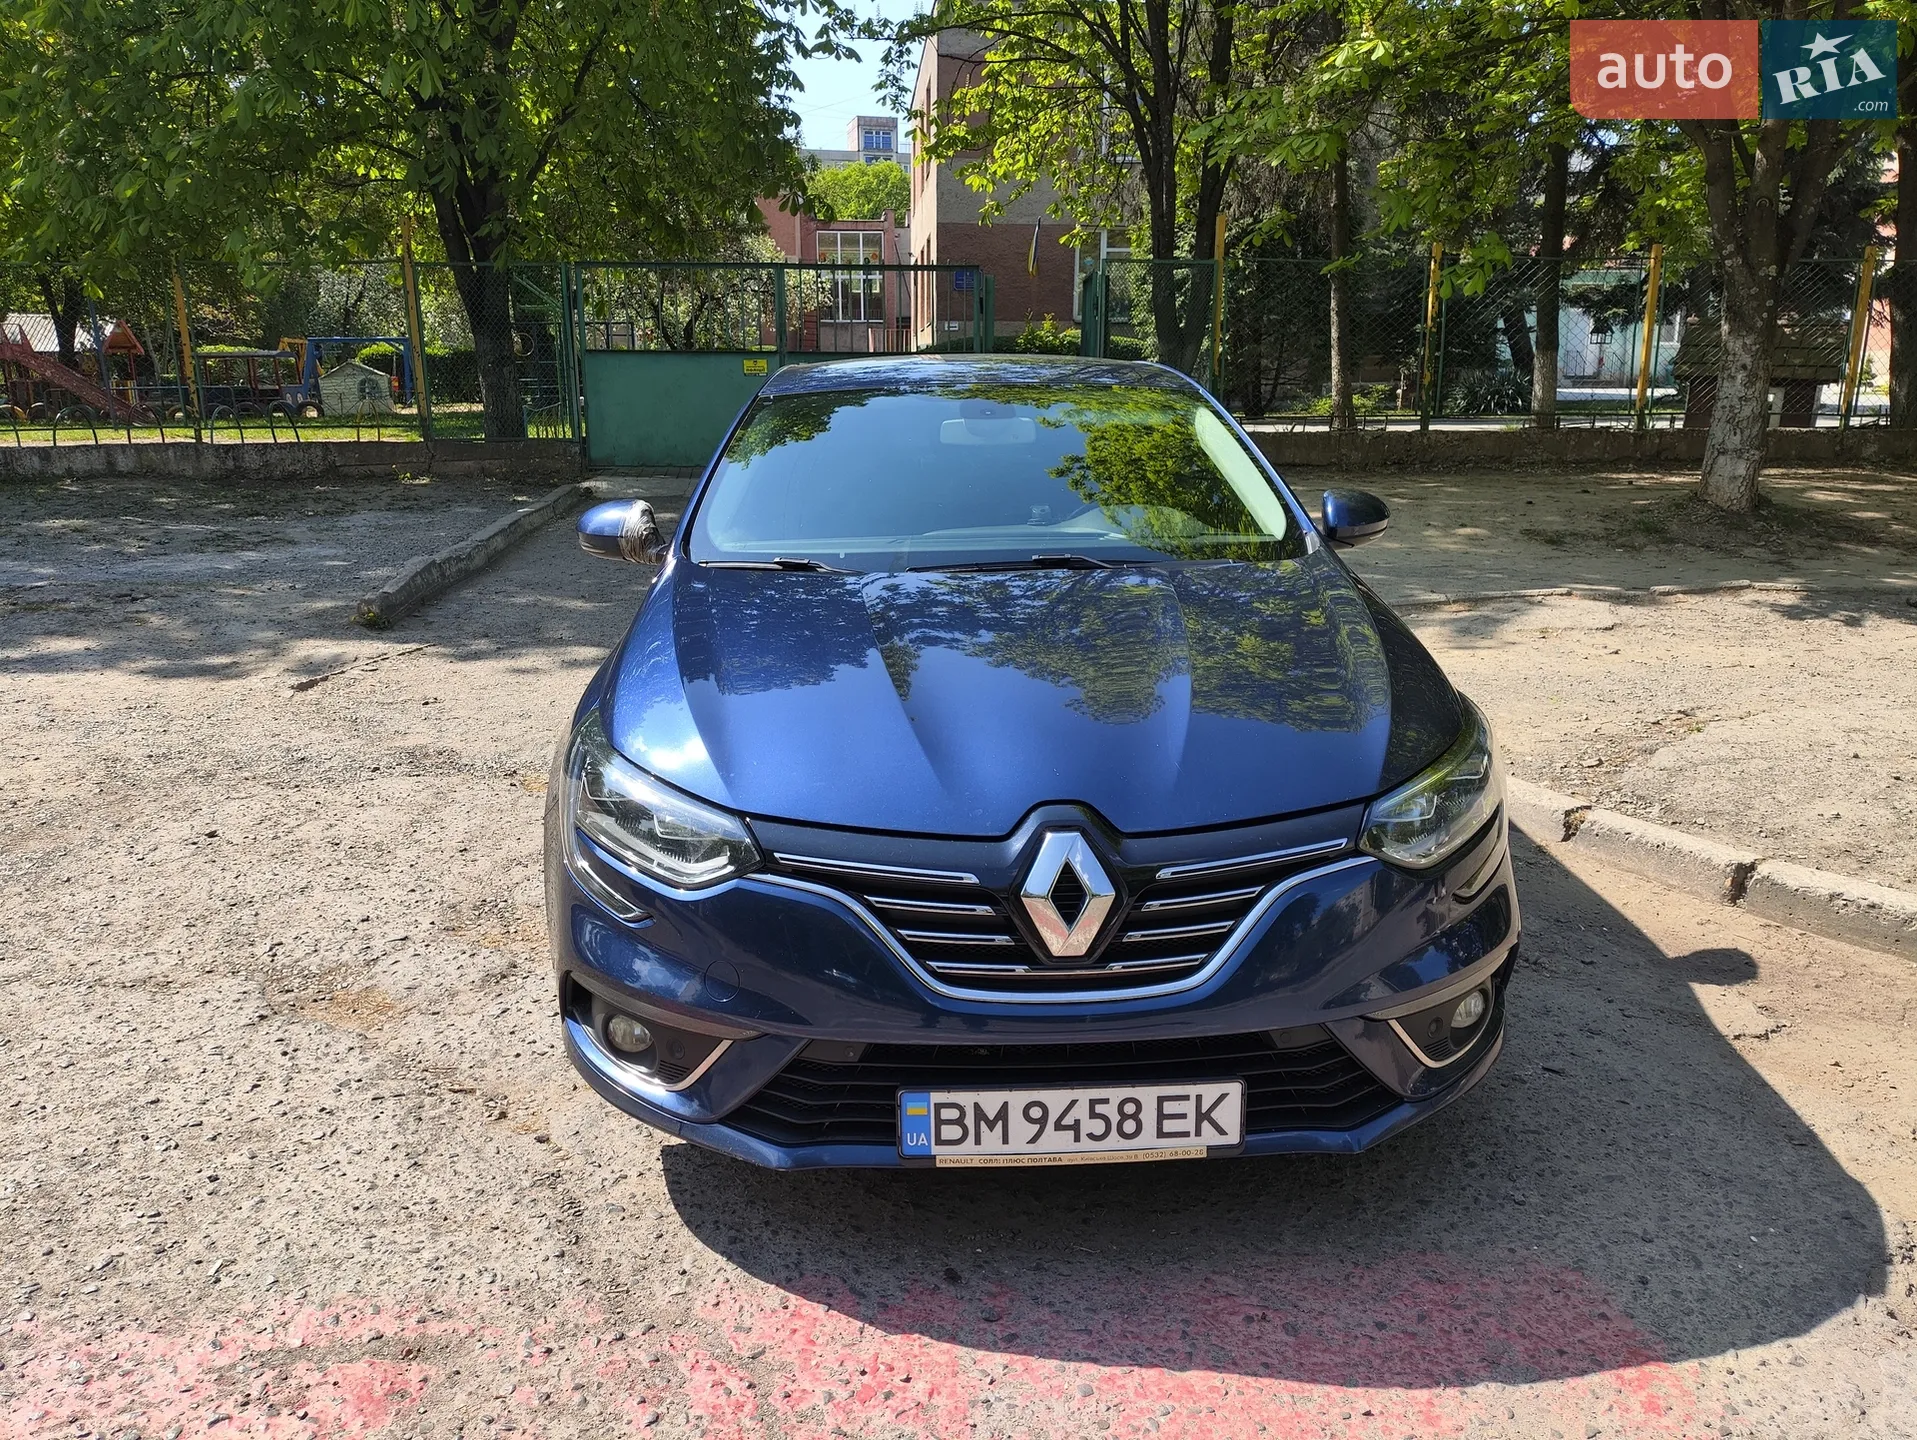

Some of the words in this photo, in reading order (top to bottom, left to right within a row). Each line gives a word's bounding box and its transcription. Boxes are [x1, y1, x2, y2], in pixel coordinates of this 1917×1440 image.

[933, 1100, 1009, 1147] BM
[1022, 1096, 1143, 1145] 9458
[1155, 1092, 1230, 1139] EK
[906, 1132, 929, 1146] UA
[1027, 1156, 1063, 1164] ПОЛТАВА
[1142, 1151, 1167, 1160] (0532)
